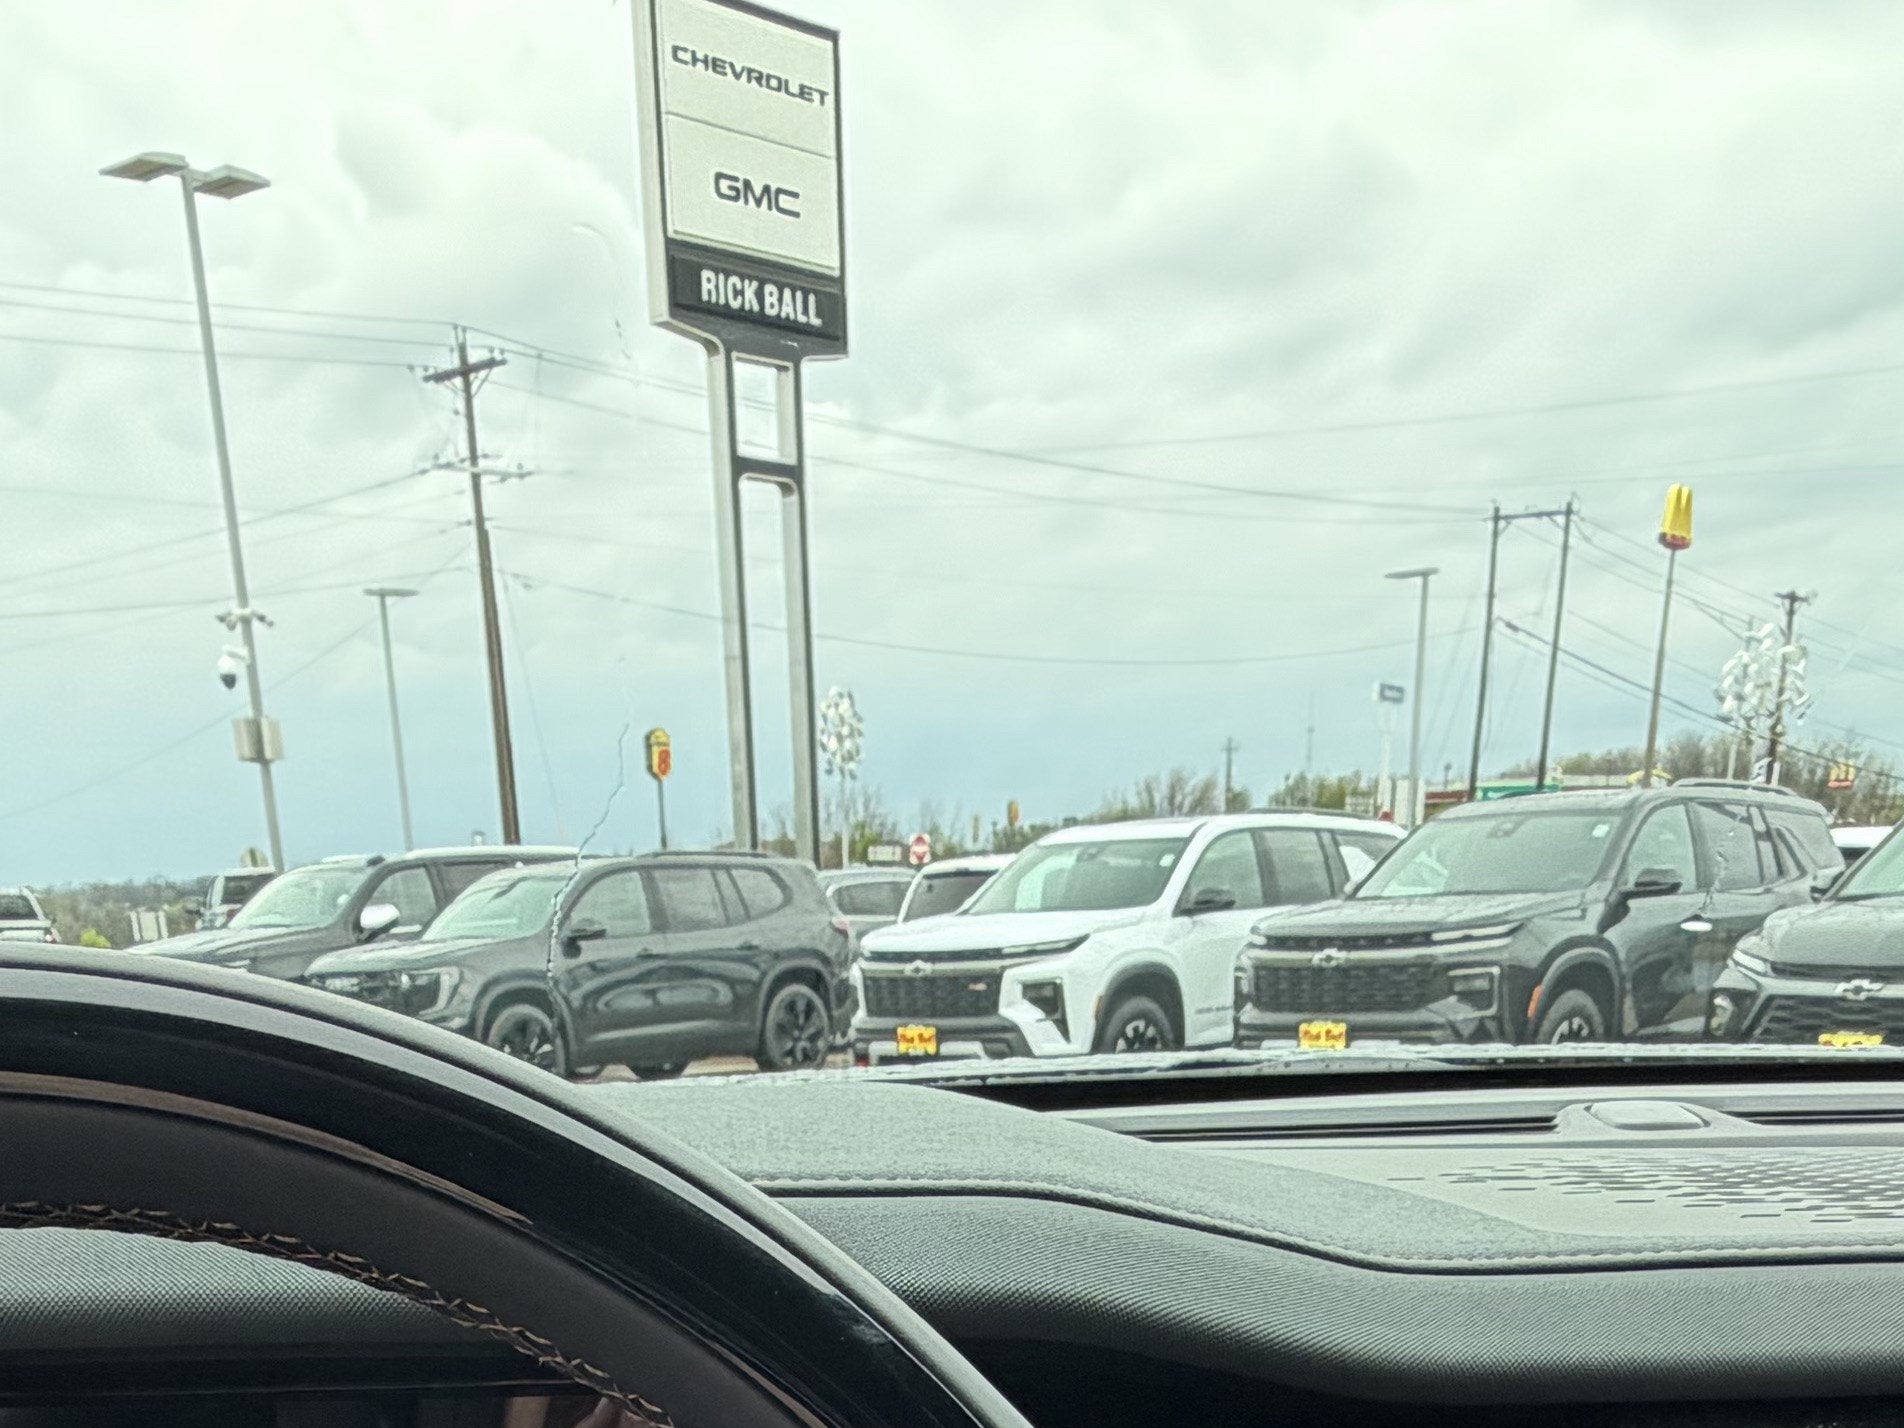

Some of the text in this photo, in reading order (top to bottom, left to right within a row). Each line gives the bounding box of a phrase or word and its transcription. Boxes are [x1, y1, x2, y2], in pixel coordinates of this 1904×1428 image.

[671, 45, 830, 107] CHEVROLET
[714, 171, 801, 218] GMC
[700, 269, 824, 327] RICK BALL
